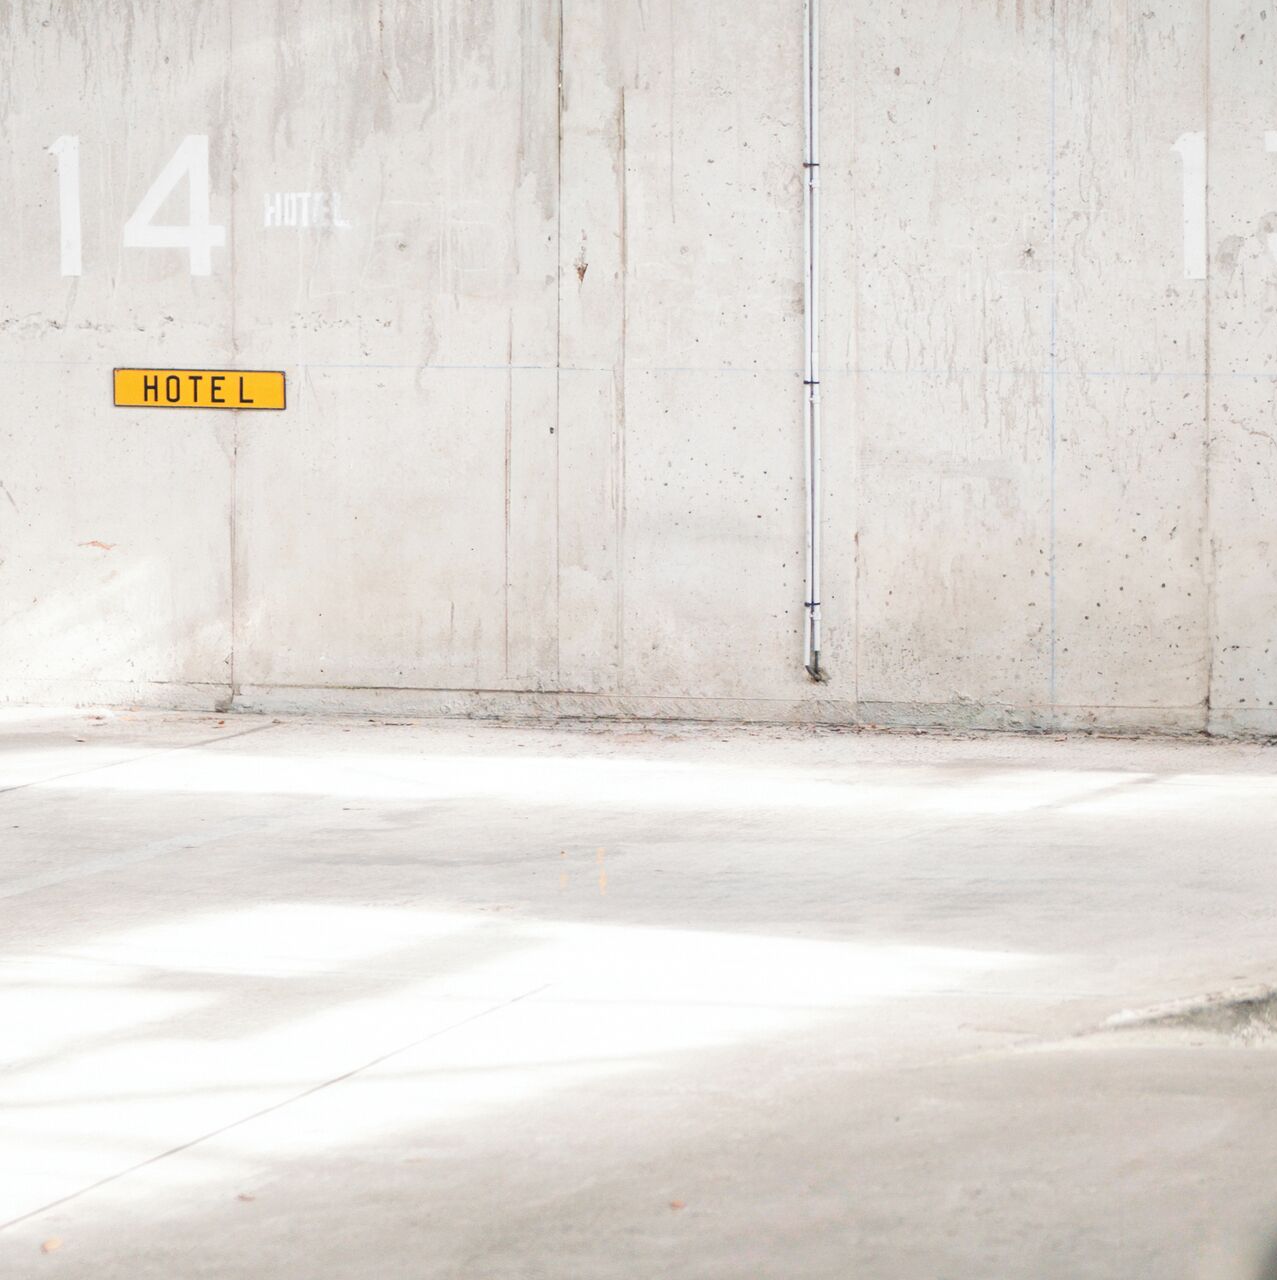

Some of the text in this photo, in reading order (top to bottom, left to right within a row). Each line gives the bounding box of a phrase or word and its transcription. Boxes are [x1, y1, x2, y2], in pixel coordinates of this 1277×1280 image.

[47, 134, 352, 277] 14 HOTEL
[143, 375, 254, 404] HOTEL
